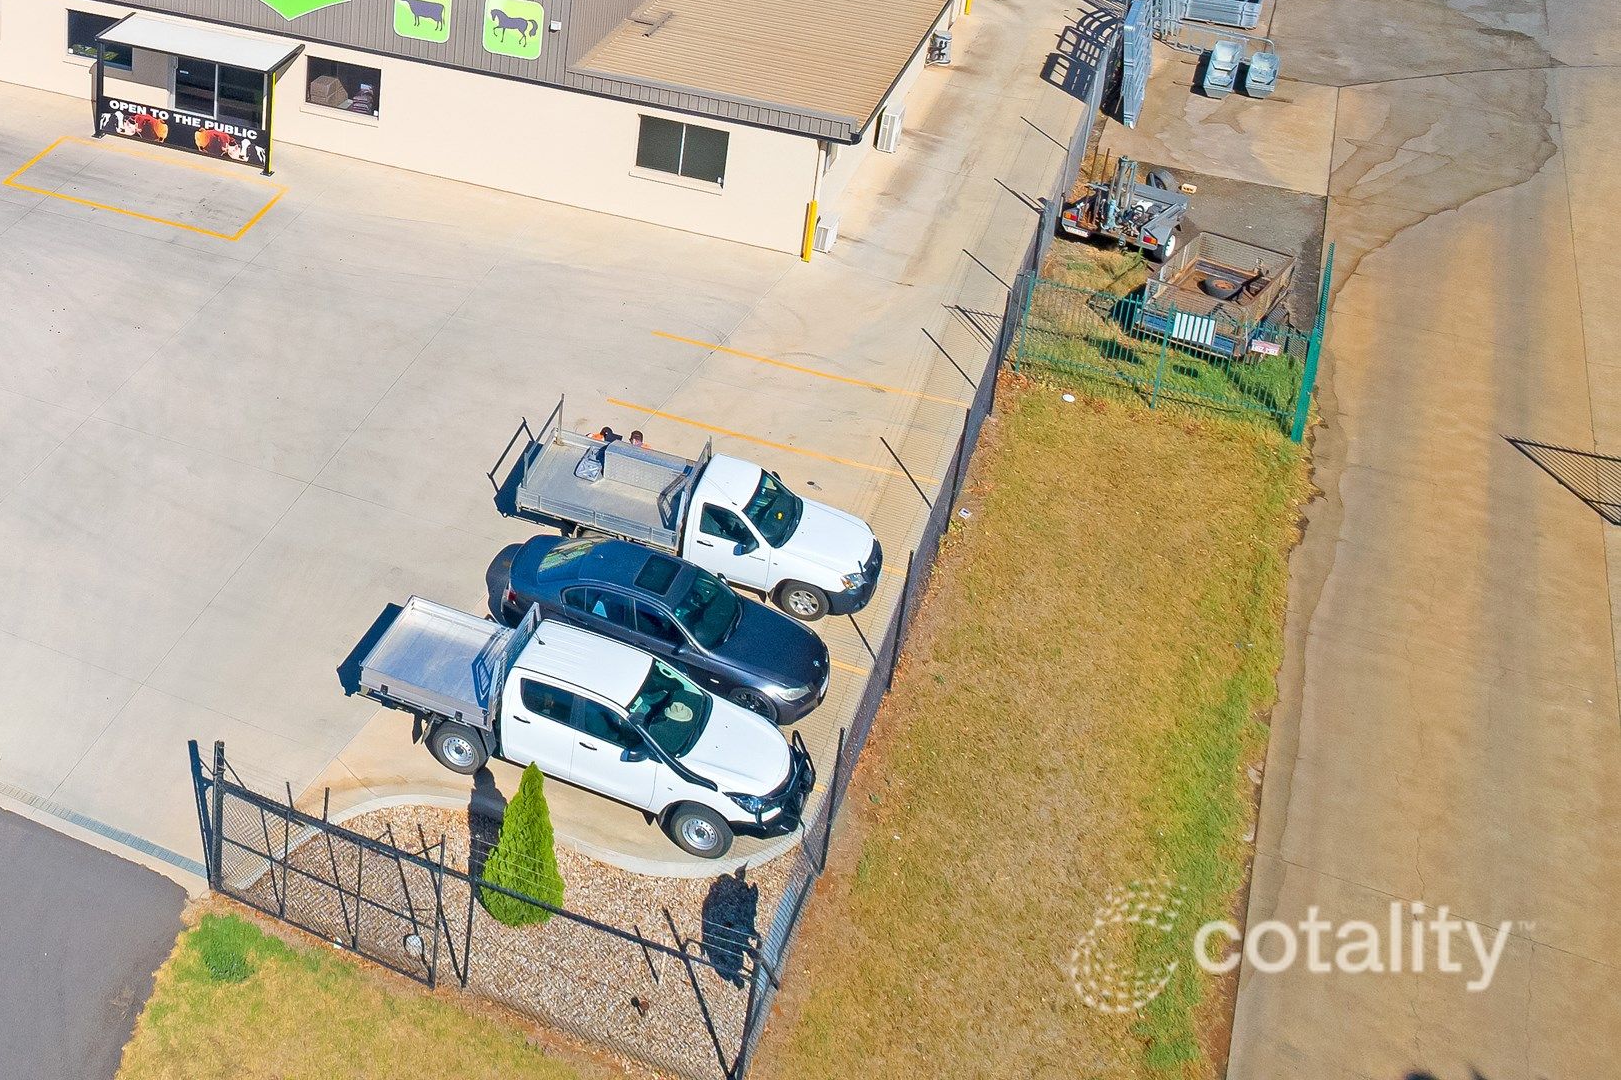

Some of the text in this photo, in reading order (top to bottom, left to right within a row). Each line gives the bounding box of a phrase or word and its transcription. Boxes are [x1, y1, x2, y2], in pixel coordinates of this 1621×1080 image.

[109, 99, 258, 140] OPEN TO THE PUBLIC
